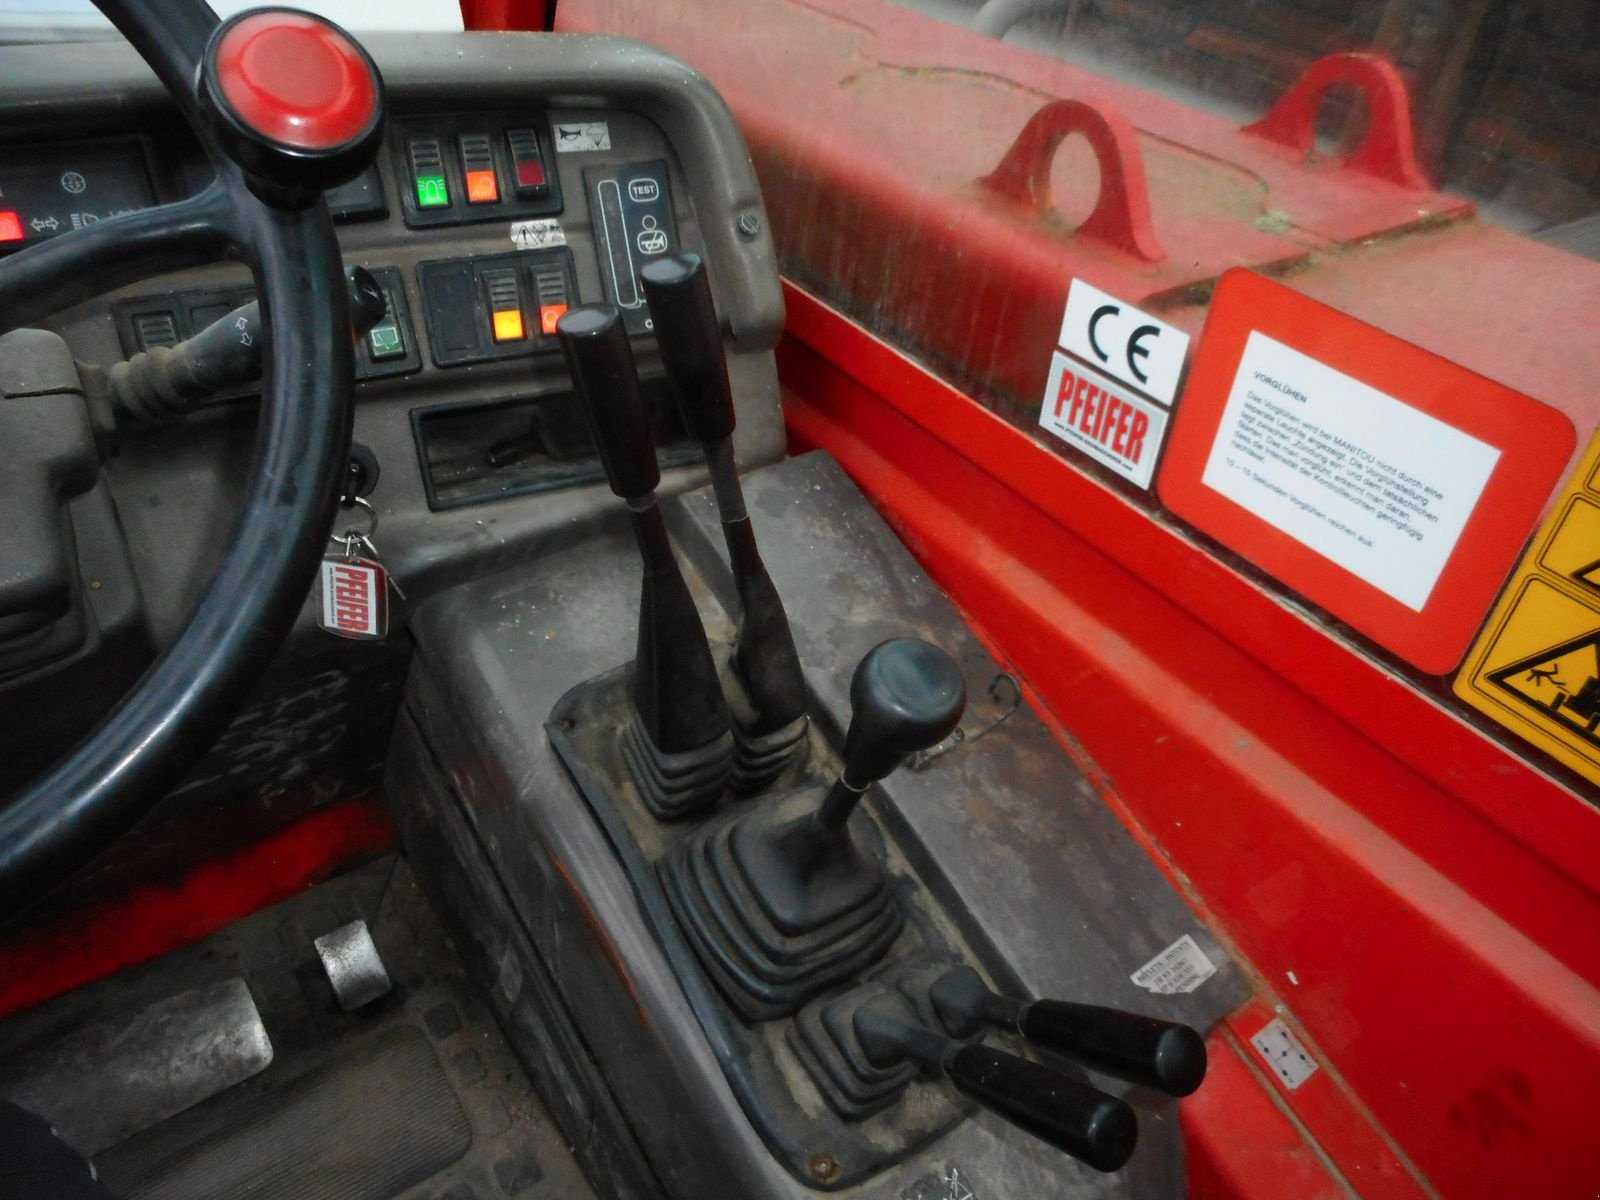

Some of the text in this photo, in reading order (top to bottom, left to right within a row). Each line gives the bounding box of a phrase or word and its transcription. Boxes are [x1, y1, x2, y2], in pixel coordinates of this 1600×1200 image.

[632, 185, 655, 195] TEST
[1088, 305, 1160, 385] CE
[1054, 368, 1149, 465] PFEIFER
[1254, 371, 1307, 403] VORGLÜHEN
[1240, 410, 1255, 424] liegt
[1256, 418, 1290, 441] zwischen
[1346, 466, 1362, 480] und
[1362, 475, 1381, 490] dem
[1382, 486, 1439, 522] tatsächlichen
[1247, 391, 1444, 499] Das Vorglühen wird bei MANITOU nicht durch eine
[1265, 434, 1281, 448] Das
[1281, 443, 1299, 458] man
[1334, 472, 1365, 494] erkennt
[1365, 489, 1385, 505] man
[1349, 457, 1363, 469] Die
[1364, 465, 1429, 506] Vorglühstellung
[1376, 508, 1424, 541] geringfügig
[335, 566, 368, 631] PFEIFER
